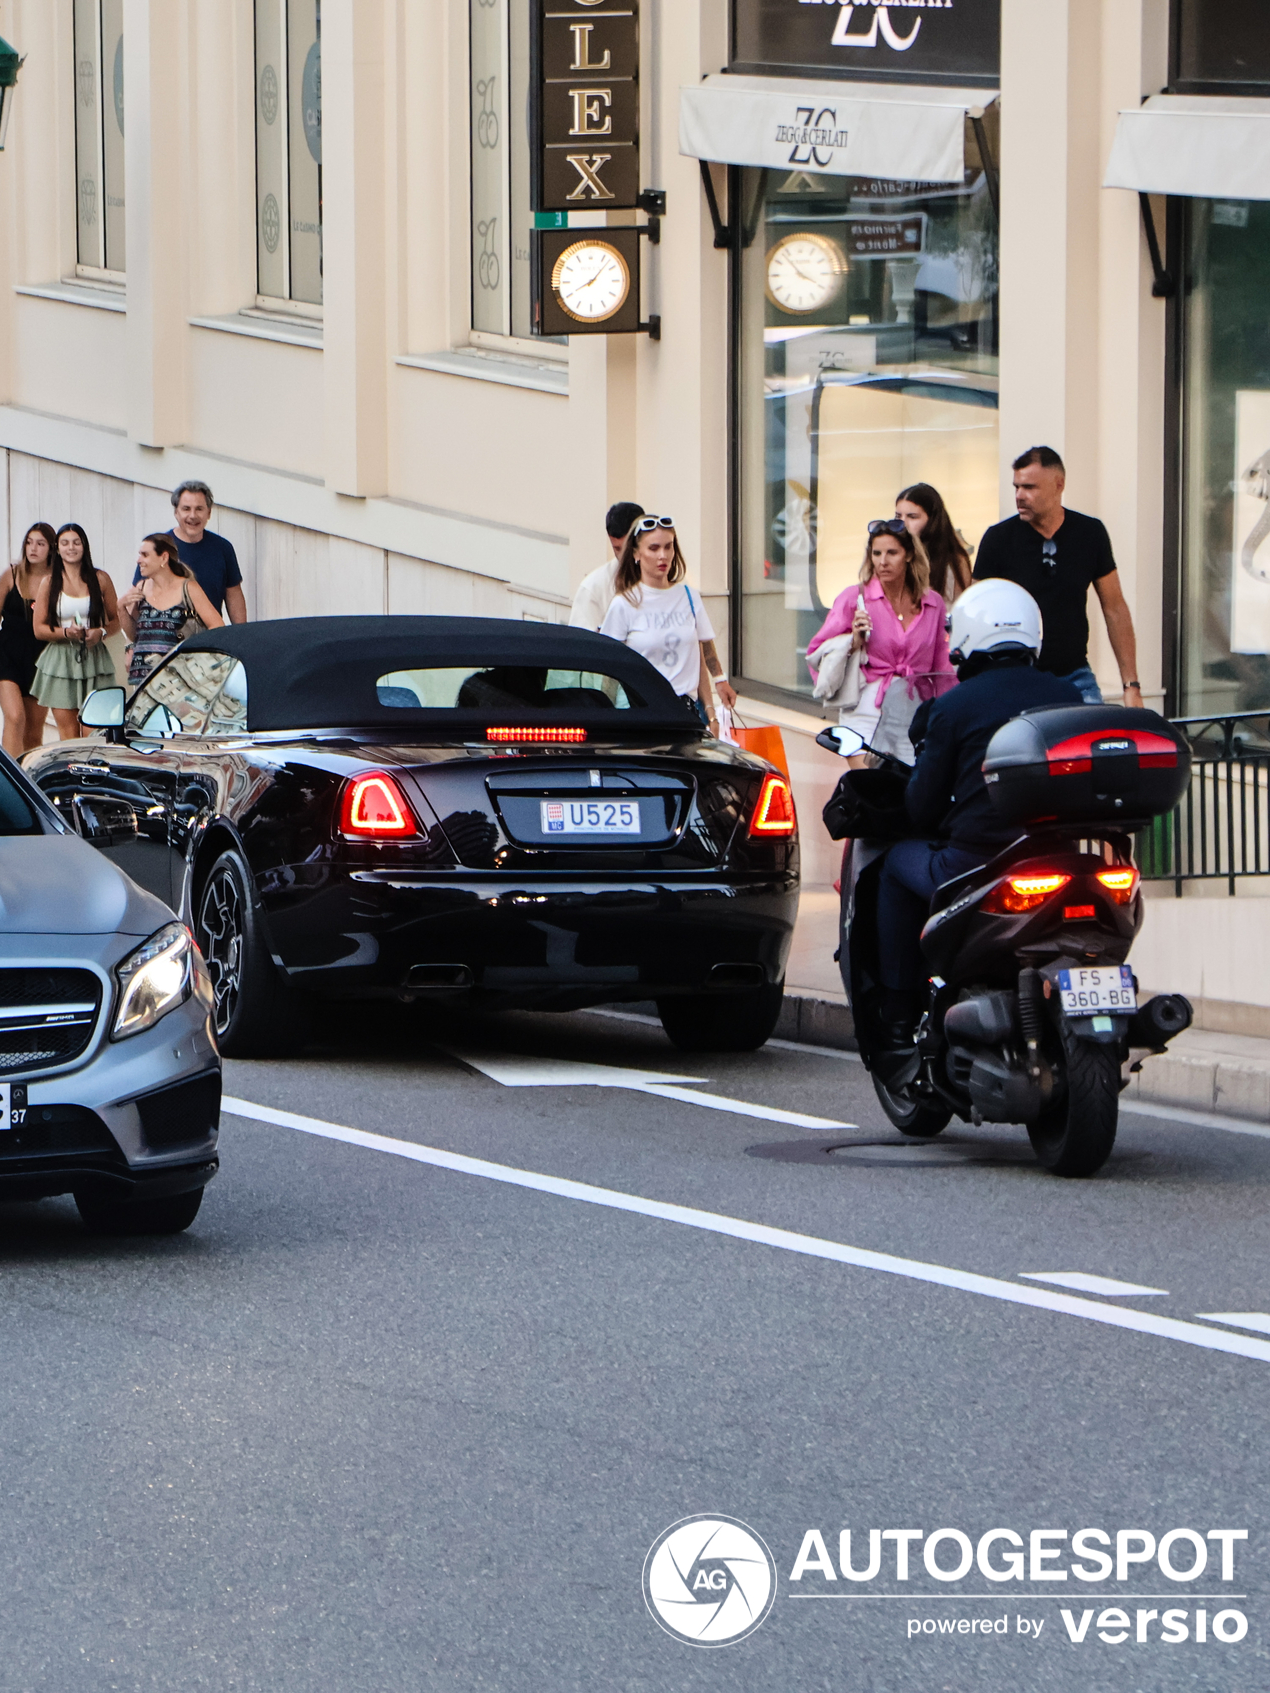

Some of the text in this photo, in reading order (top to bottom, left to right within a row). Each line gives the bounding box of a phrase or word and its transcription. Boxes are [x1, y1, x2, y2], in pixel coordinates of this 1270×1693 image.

[566, 0, 615, 200] LEX
[787, 106, 837, 168] ZC
[570, 804, 633, 826] U525
[551, 821, 562, 829] MC
[1067, 990, 1131, 1007] 360-BG
[11, 1109, 26, 1123] 37
